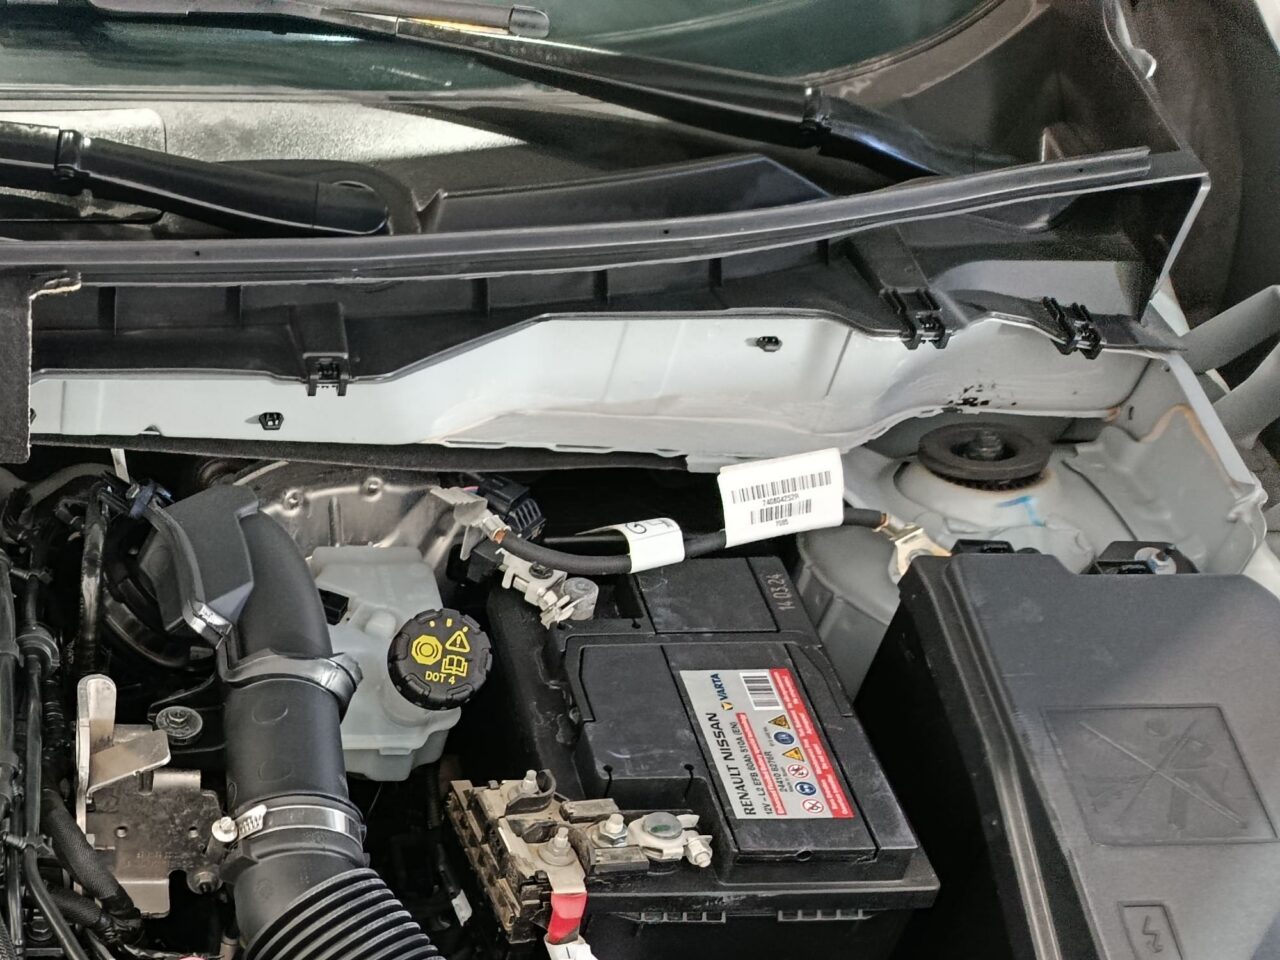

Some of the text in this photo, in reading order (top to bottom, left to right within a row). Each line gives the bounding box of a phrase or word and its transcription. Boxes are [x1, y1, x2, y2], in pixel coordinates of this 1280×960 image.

[425, 670, 456, 685] DOT 4
[710, 673, 728, 700] VARTA
[706, 712, 756, 815] RENAULT NISSAN
[750, 772, 761, 786] EFB
